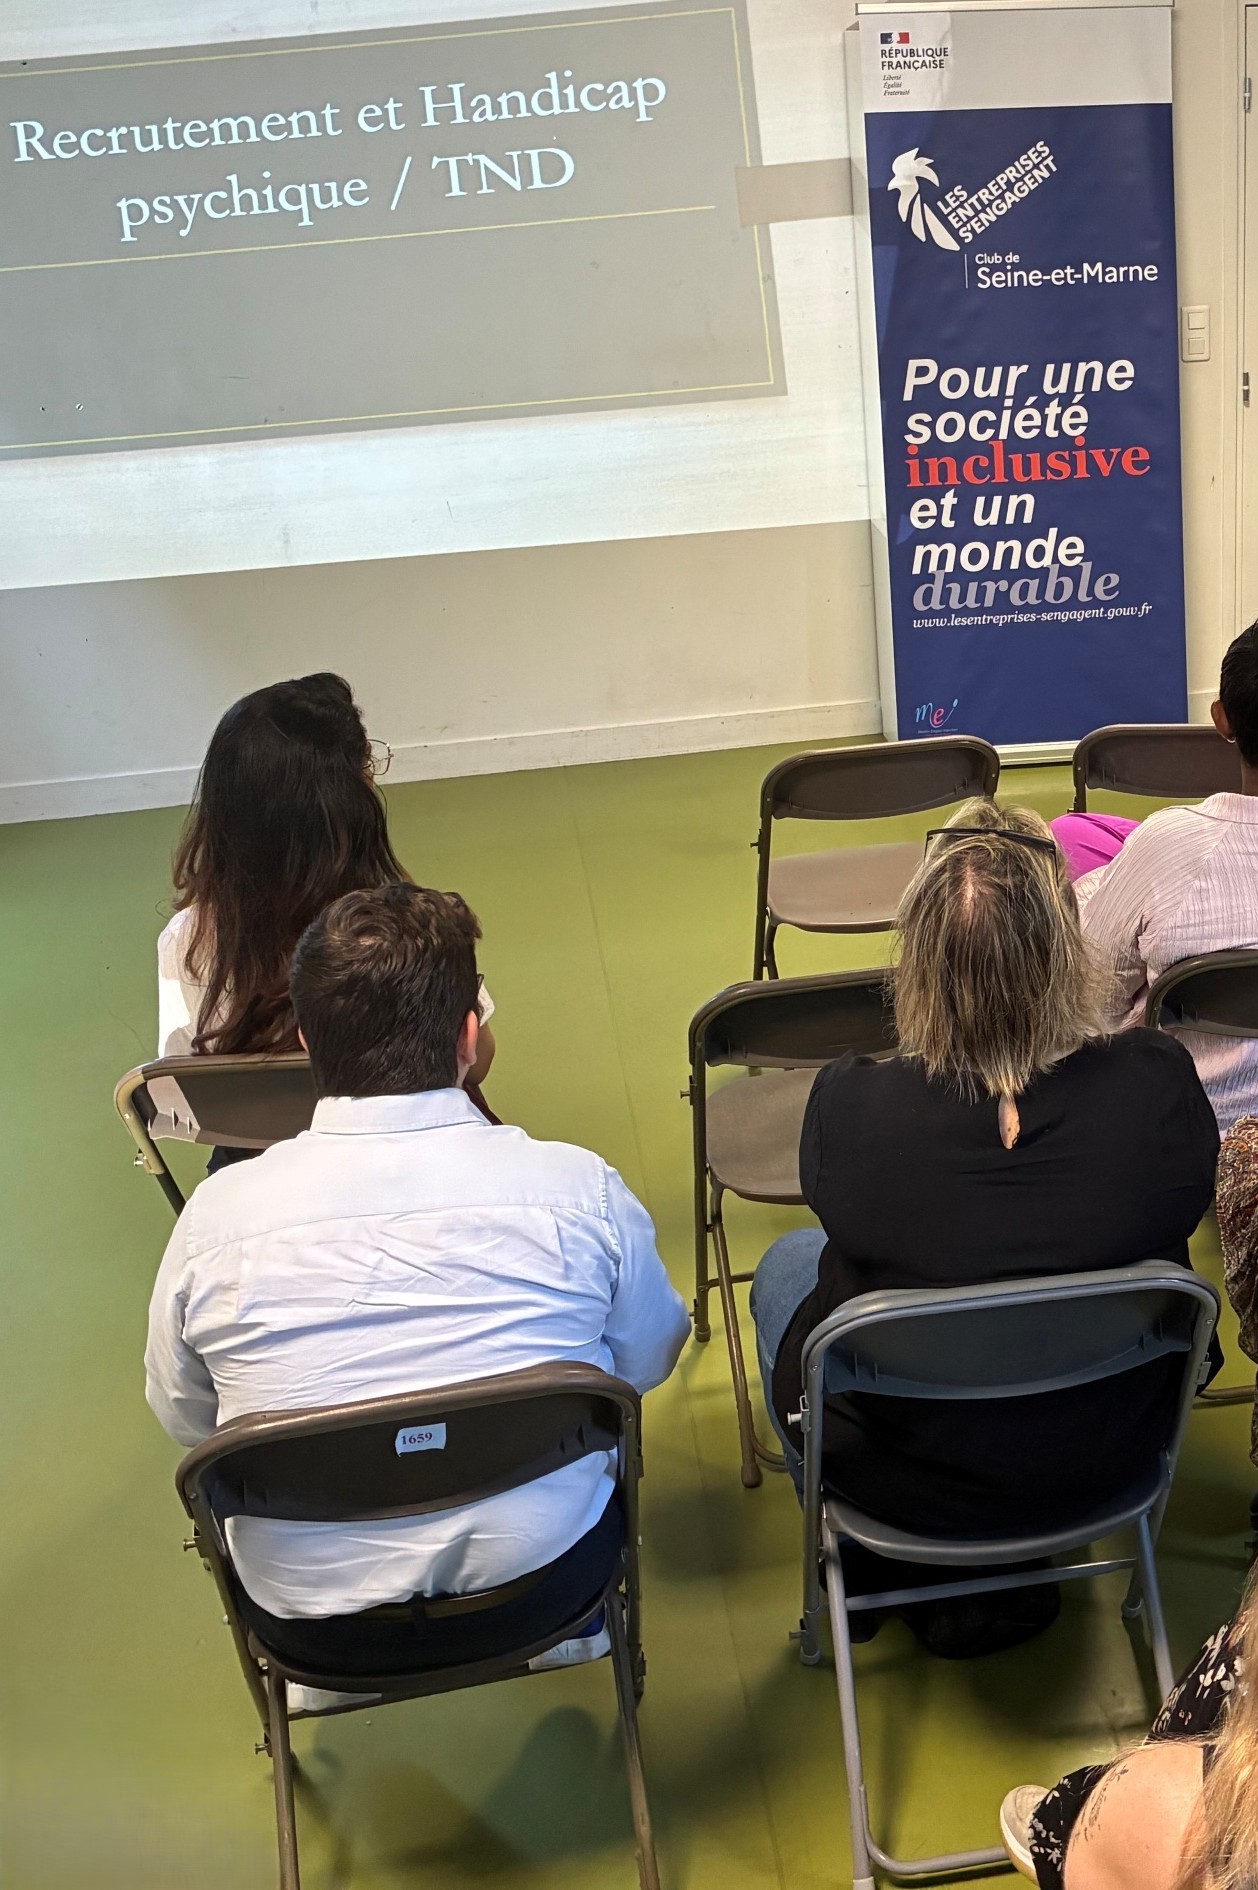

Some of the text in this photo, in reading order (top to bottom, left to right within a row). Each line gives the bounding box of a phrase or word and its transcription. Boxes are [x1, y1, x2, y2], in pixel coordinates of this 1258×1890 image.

[880, 46, 949, 59] RÉPUBLIQUE
[881, 59, 945, 72] FRANÇAISE
[10, 69, 667, 162] Recrutement et Handicap
[116, 147, 575, 242] psychique / TND
[937, 185, 968, 215] LES
[947, 141, 1050, 229] ENTREPRISES
[958, 155, 1057, 243] S'ENGAGENT
[975, 251, 1020, 265] Club de
[976, 261, 1159, 290] Seine-et-Marne
[903, 358, 1135, 402] Pour une
[904, 393, 1089, 445] société
[905, 436, 1151, 487] inclusive
[909, 488, 1035, 529] et un
[912, 527, 1085, 575] monde
[912, 561, 1120, 612] durable
[912, 602, 1153, 629] www.lesentreprises-sengagent.gouv.fr
[401, 1432, 433, 1445] 1659
